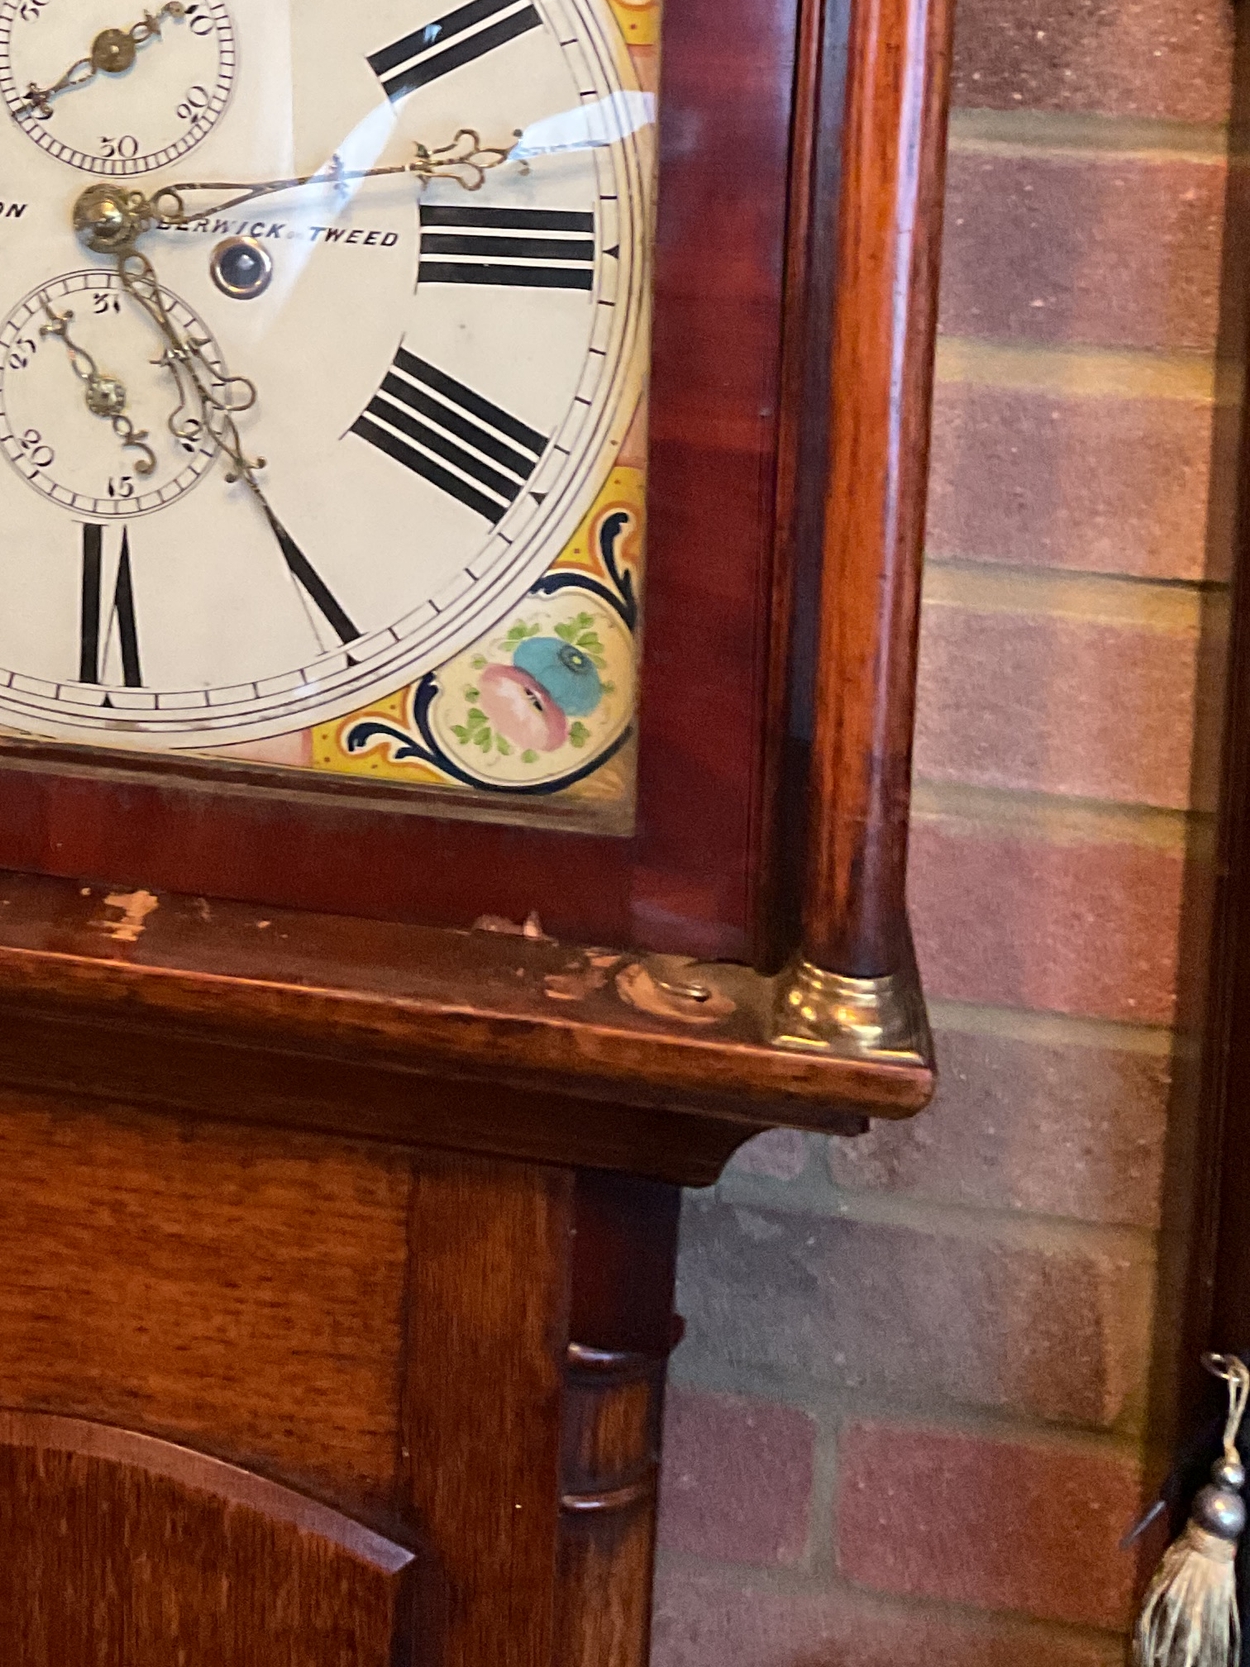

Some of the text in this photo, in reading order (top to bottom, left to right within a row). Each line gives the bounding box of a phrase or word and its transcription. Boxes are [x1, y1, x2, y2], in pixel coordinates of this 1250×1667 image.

[176, 86, 209, 124] 20
[99, 135, 138, 158] 30
[309, 225, 399, 247] TWEED
[415, 194, 596, 300] III
[19, 430, 55, 467] 20
[341, 333, 558, 533] IIII
[107, 476, 135, 498] 15
[73, 519, 147, 690] VI
[268, 516, 372, 656] V
